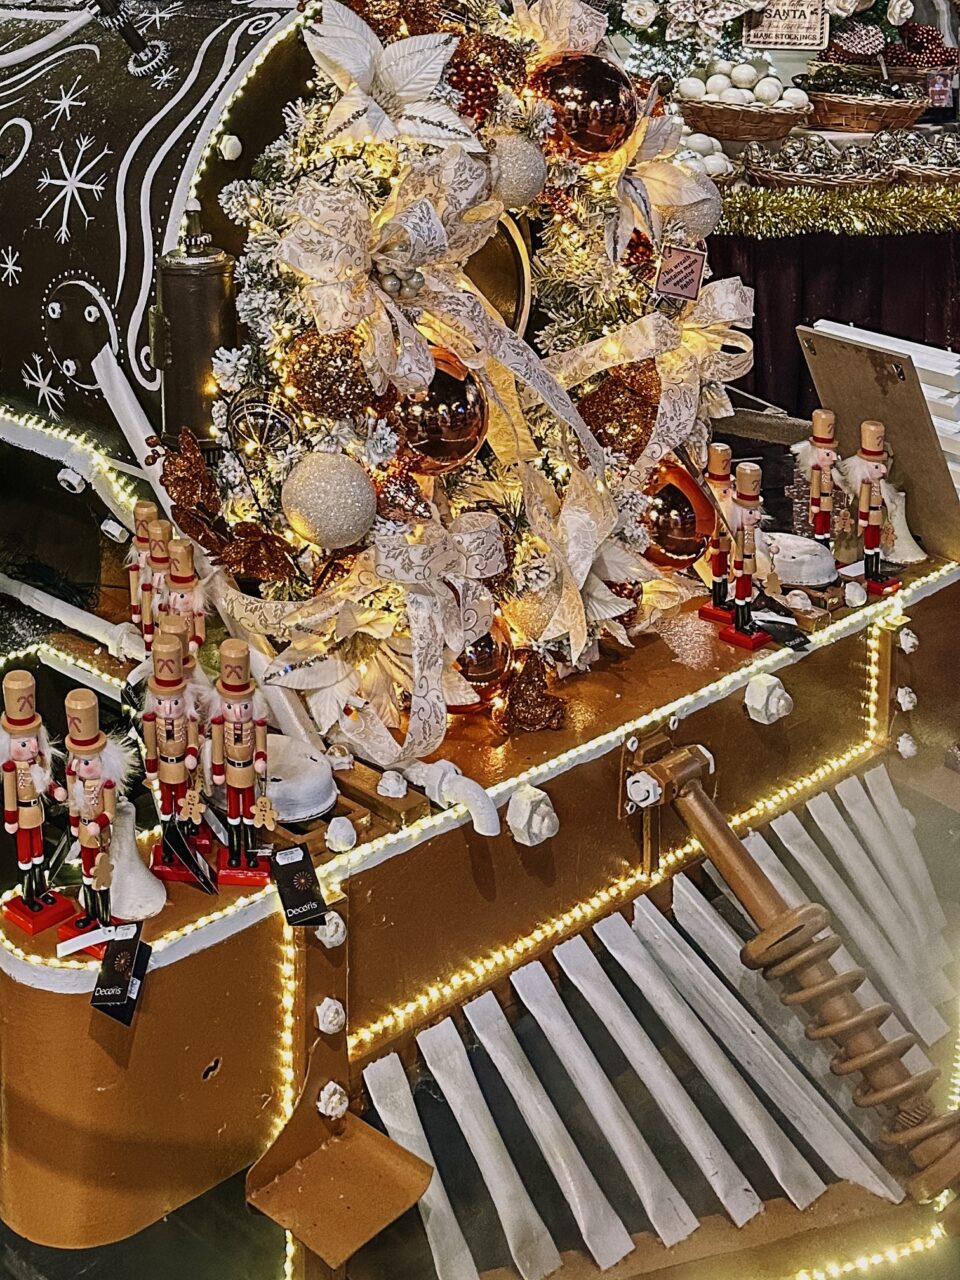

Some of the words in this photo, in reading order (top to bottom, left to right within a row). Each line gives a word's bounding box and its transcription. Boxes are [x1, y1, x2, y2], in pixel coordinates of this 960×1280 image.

[764, 8, 807, 21] SANTA
[775, 33, 817, 41] STOCKINGS
[662, 268, 674, 277] This
[673, 255, 691, 269] wreath
[662, 269, 684, 287] contains
[683, 258, 698, 271] mains
[673, 268, 695, 287] operated
[680, 277, 695, 290] lights
[287, 901, 319, 917] Decoris
[94, 986, 123, 996] Decoris
